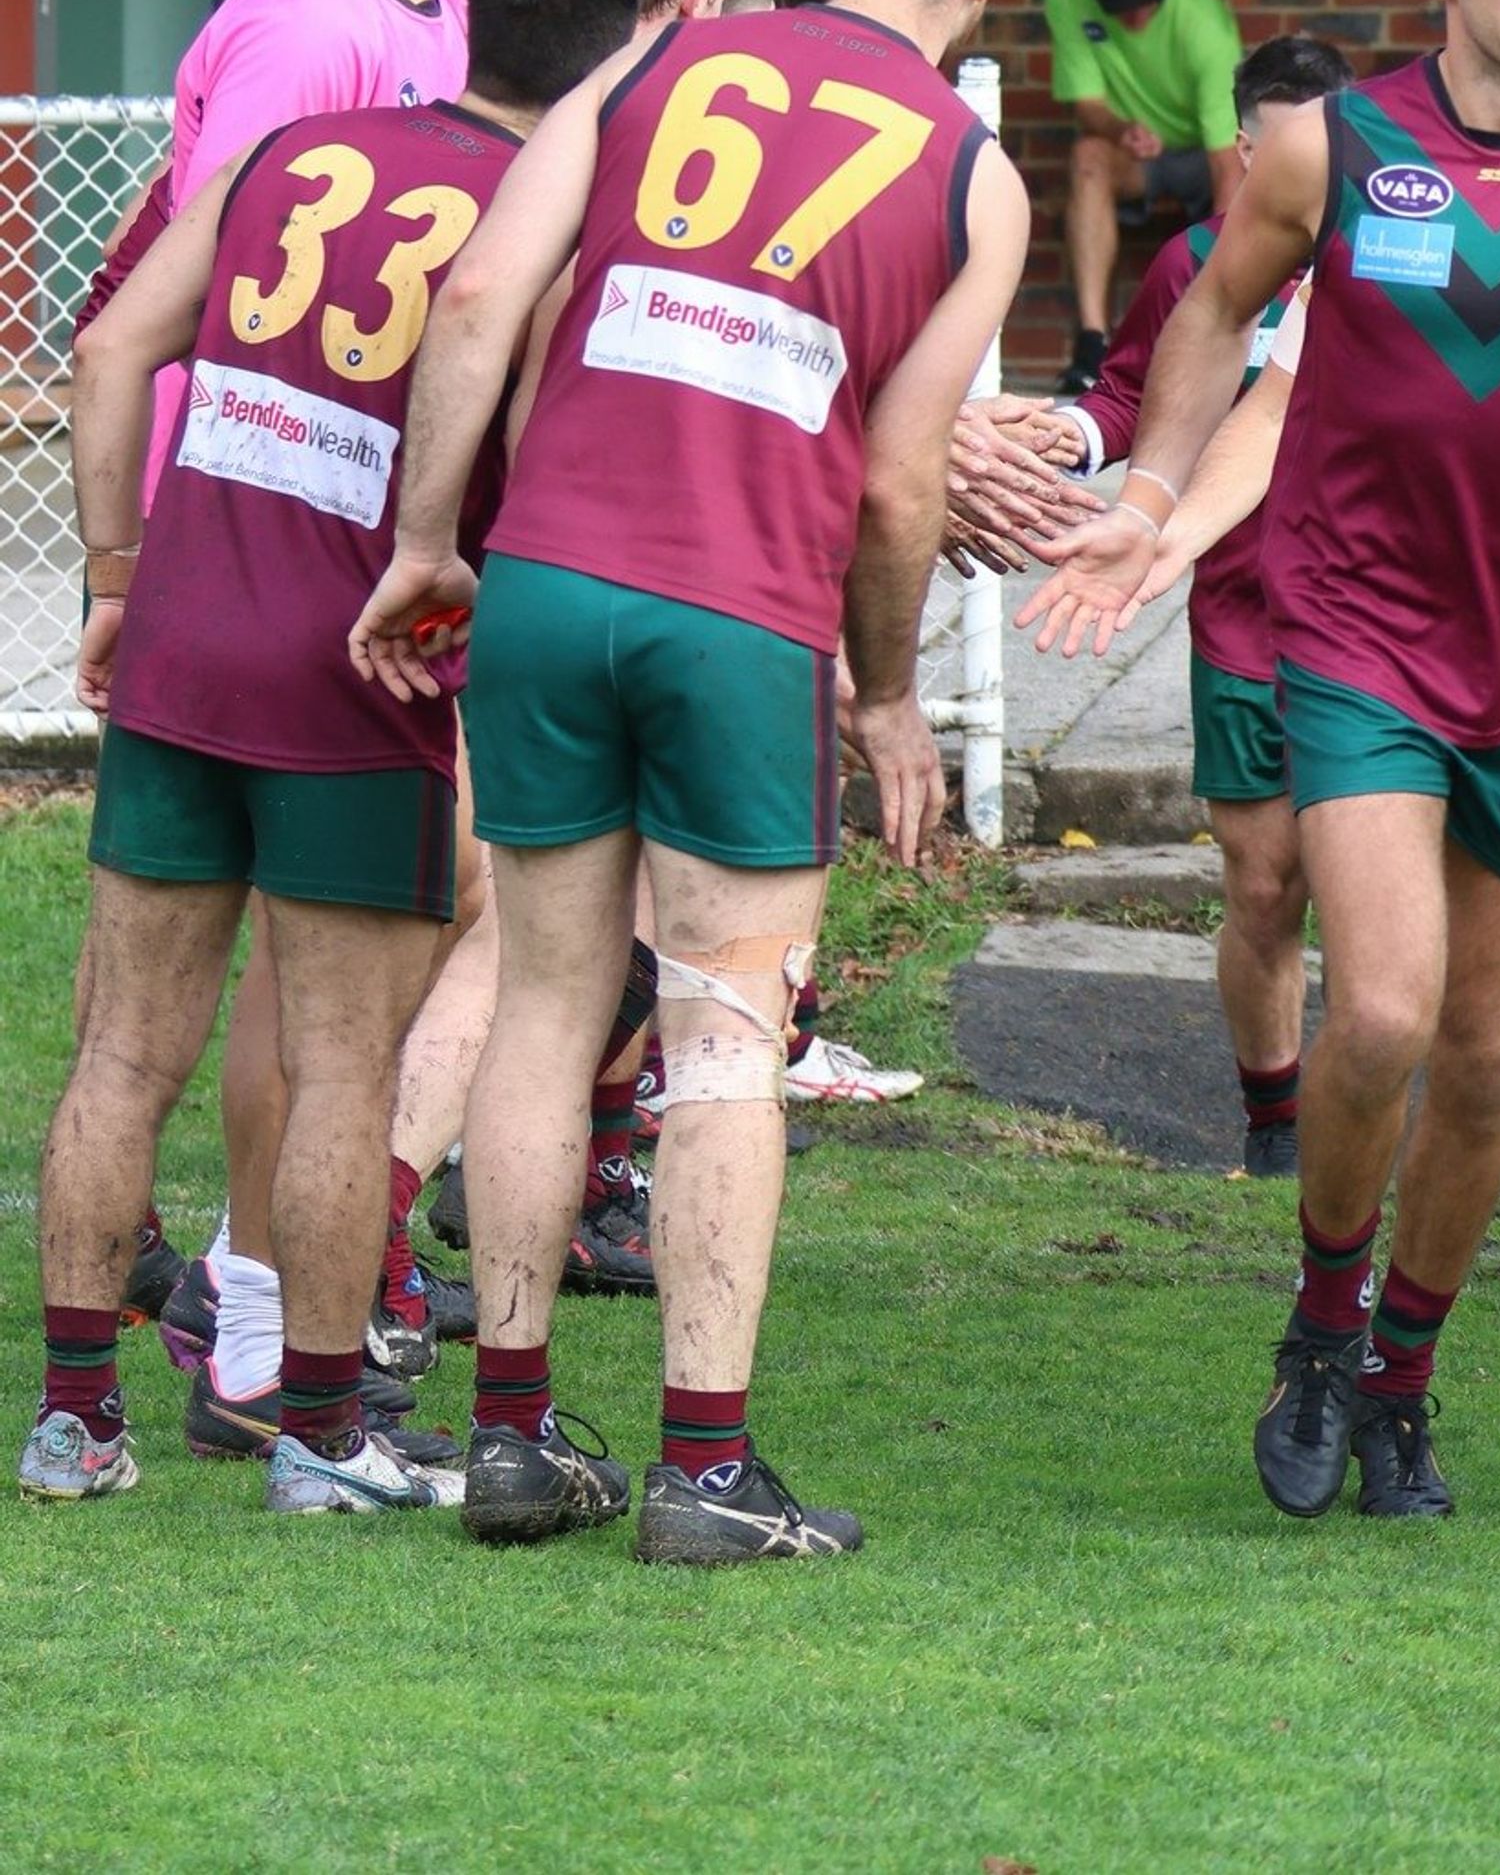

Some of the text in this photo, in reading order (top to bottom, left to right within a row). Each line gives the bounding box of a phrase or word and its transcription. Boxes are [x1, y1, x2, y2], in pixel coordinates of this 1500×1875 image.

[634, 52, 936, 283] 67
[1376, 177, 1444, 203] VAFA
[229, 143, 480, 382] 33
[647, 290, 835, 377] BendigoWealth
[221, 389, 381, 472] BendigoWealth
